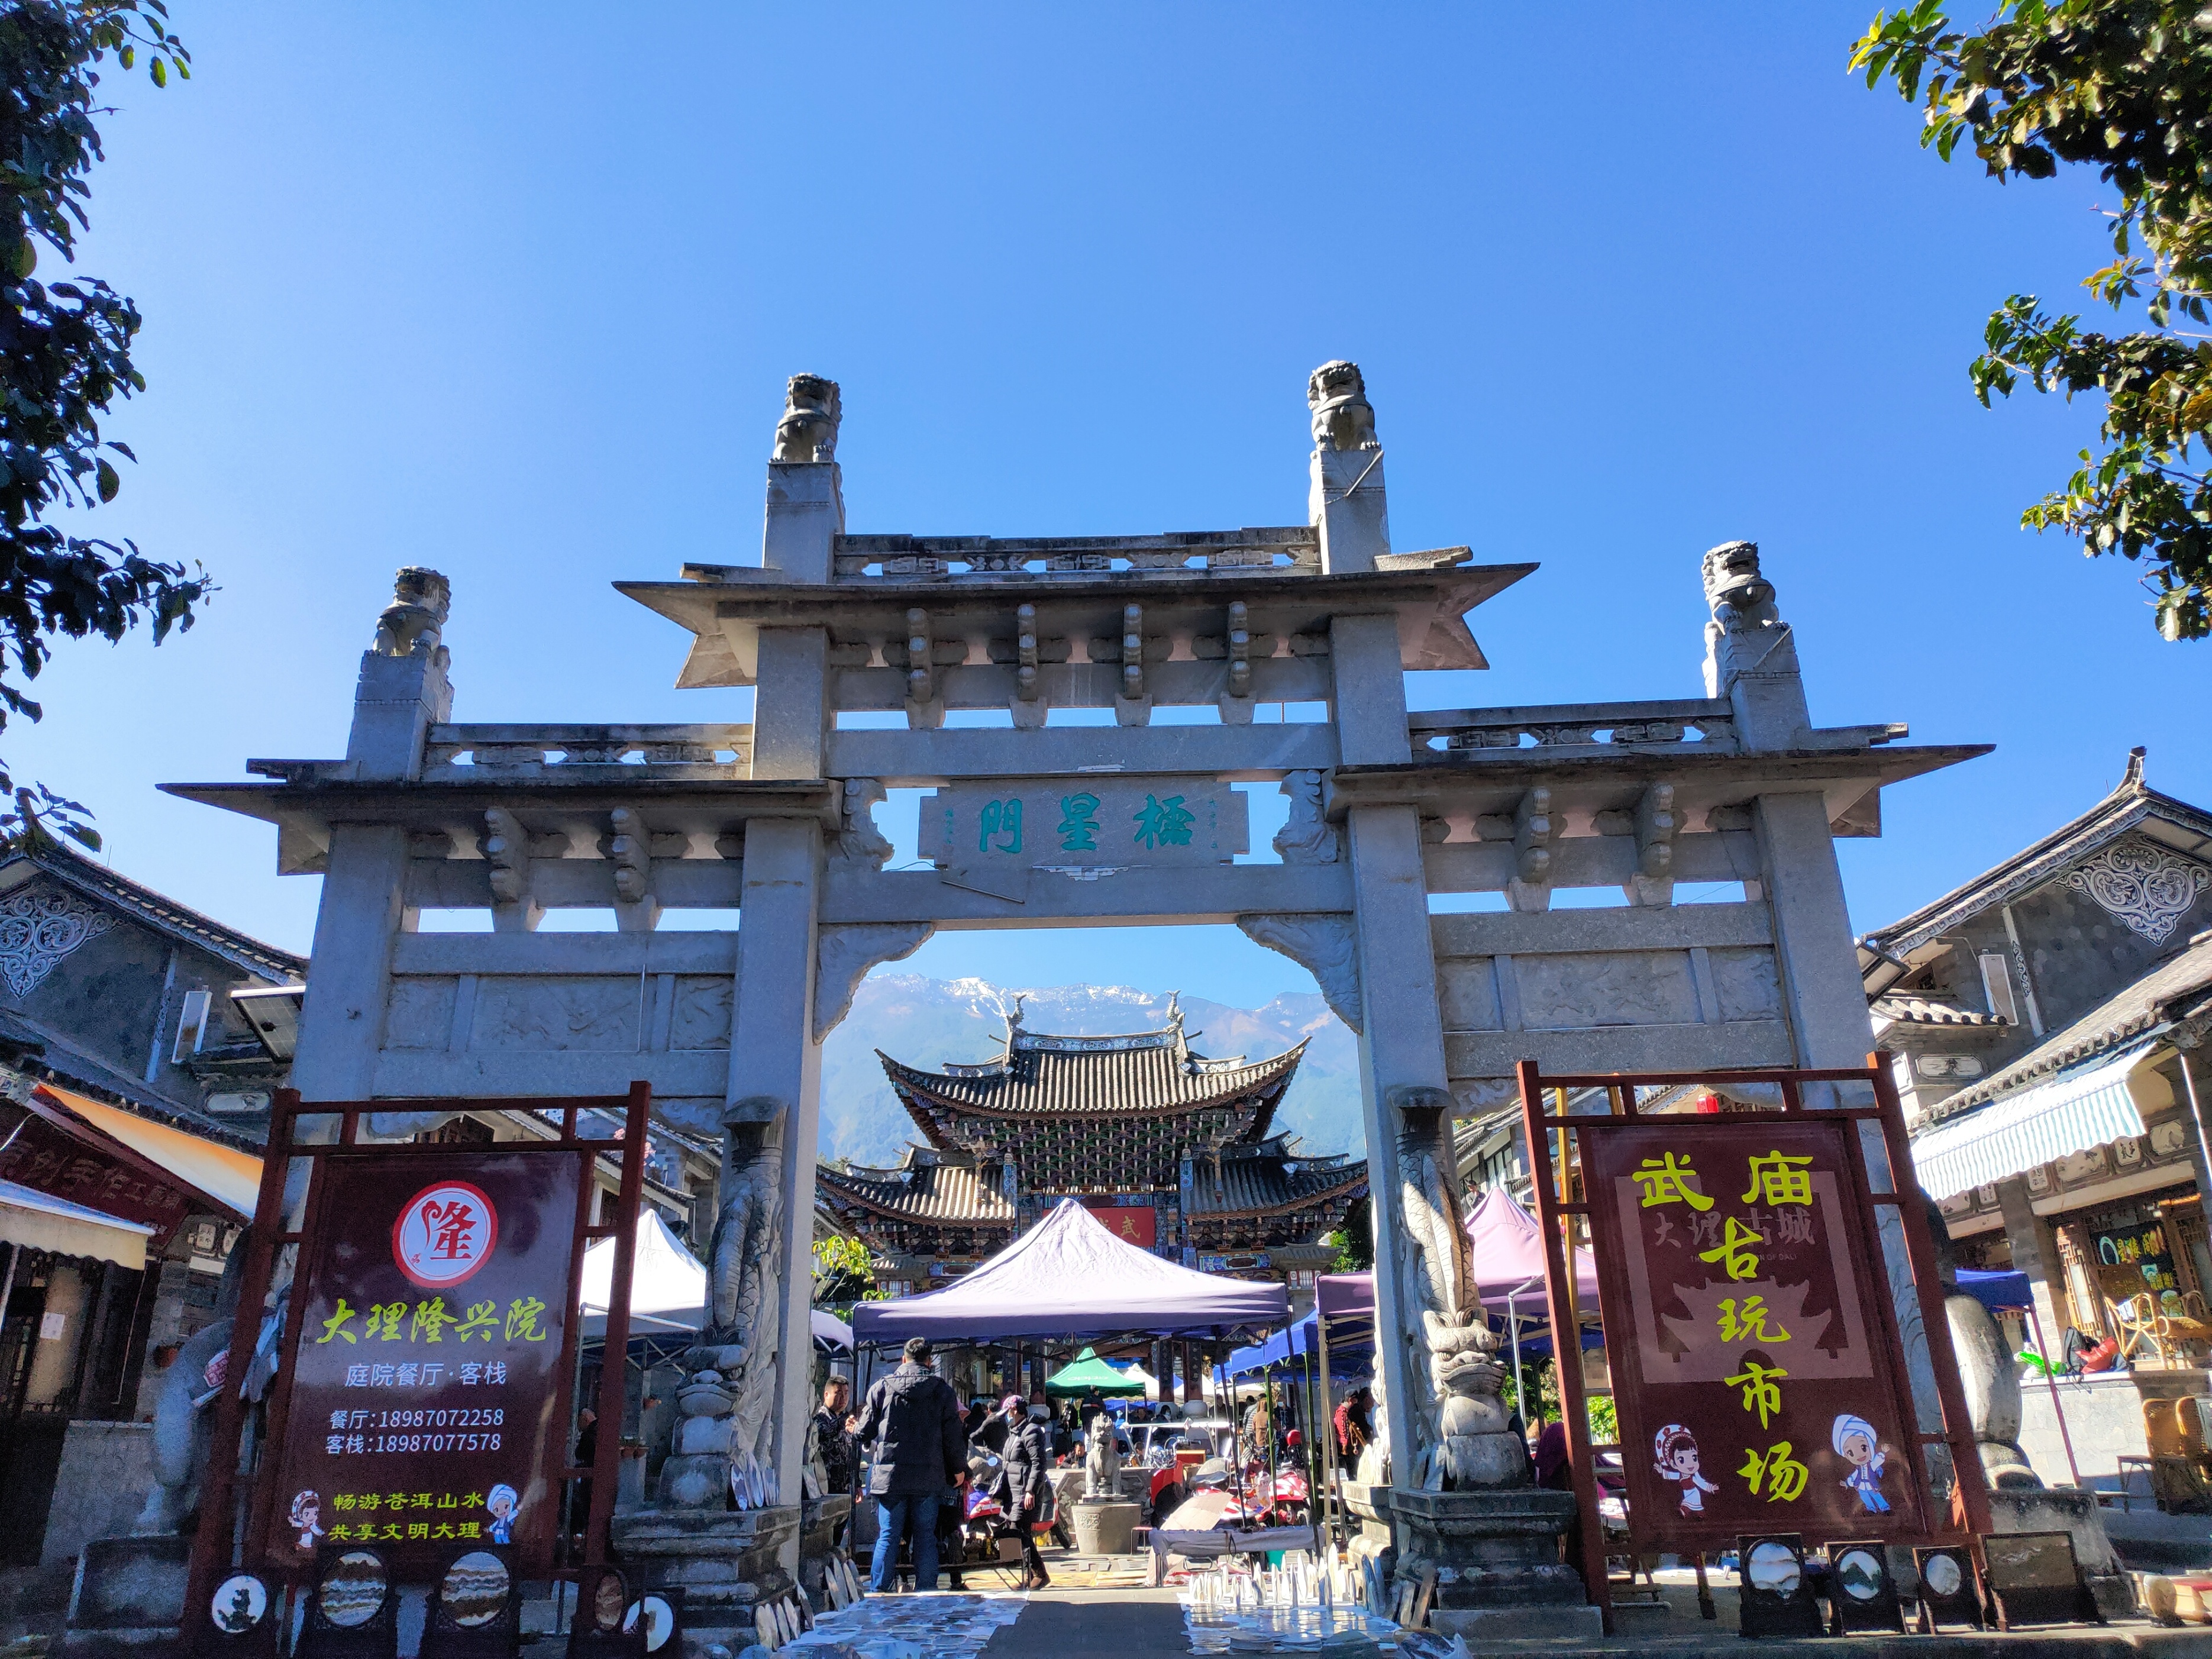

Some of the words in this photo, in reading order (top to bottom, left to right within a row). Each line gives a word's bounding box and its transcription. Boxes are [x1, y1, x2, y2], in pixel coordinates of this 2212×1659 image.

[1632, 1150, 1814, 1212] 武庙
[316, 1296, 547, 1344] 大理隆兴院
[1698, 1216, 1809, 1502] 古玩市场
[333, 1492, 485, 1510] 畅游苍洱山水
[328, 1522, 482, 1541] 共享文明大理
